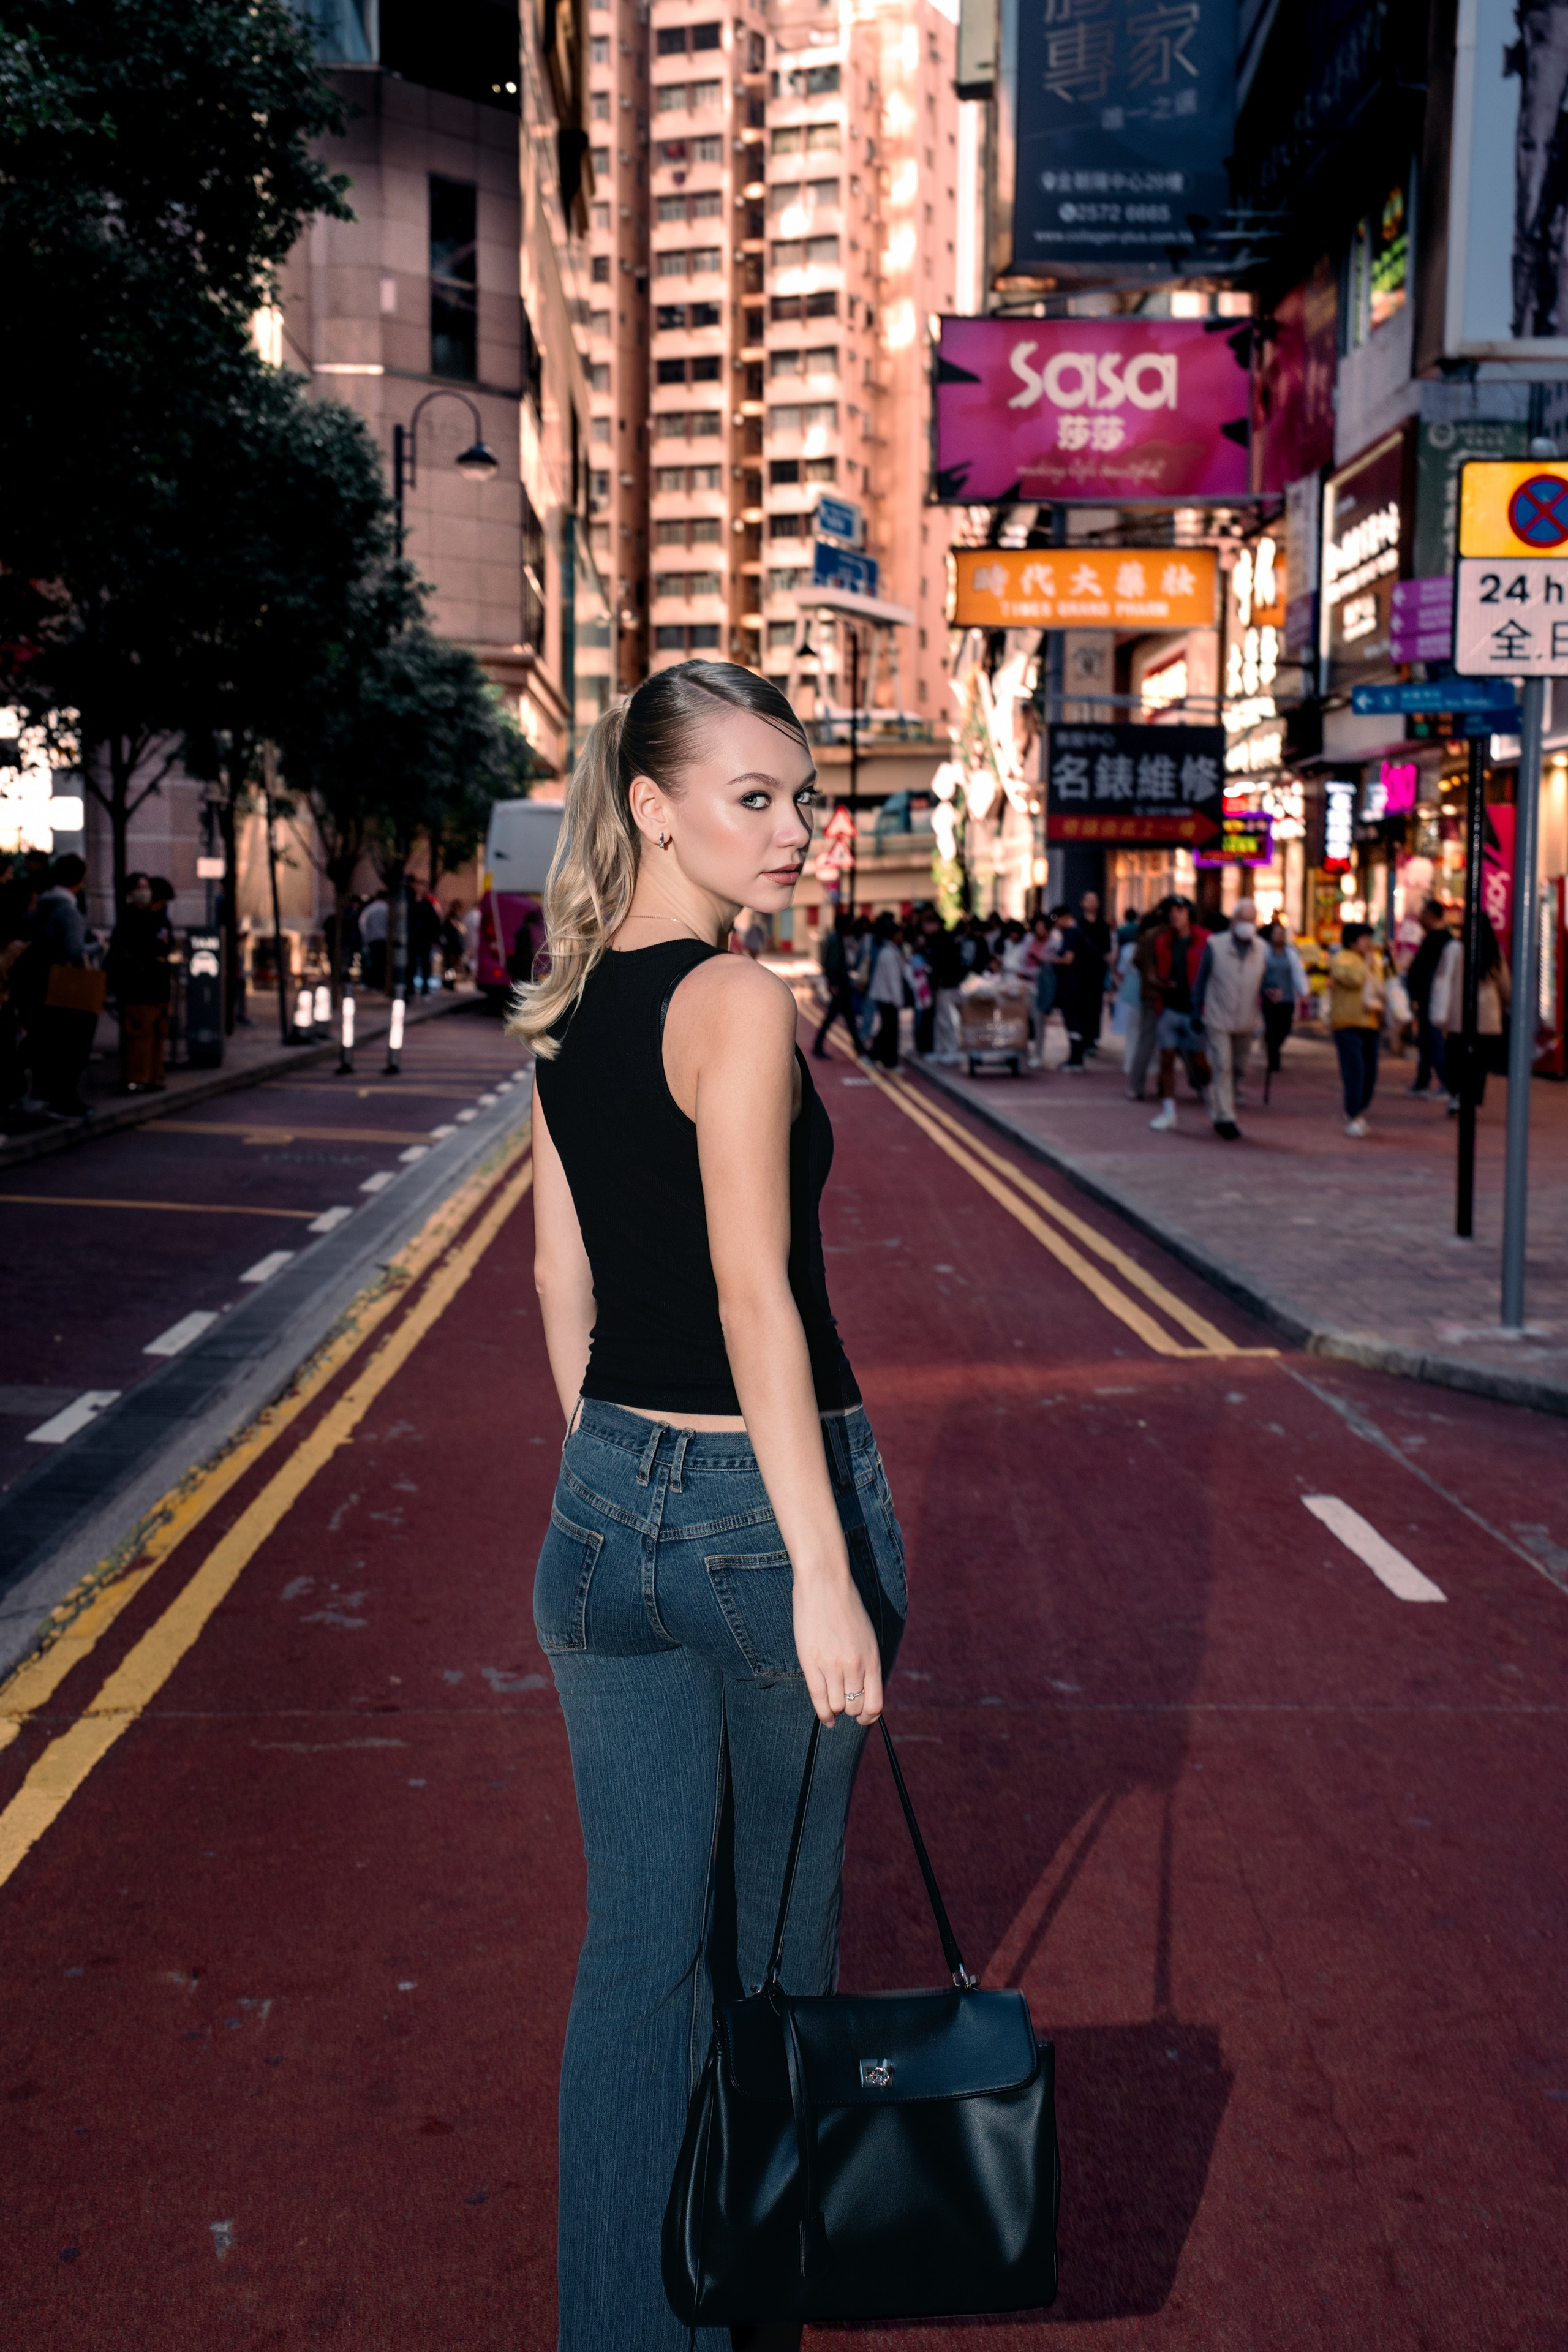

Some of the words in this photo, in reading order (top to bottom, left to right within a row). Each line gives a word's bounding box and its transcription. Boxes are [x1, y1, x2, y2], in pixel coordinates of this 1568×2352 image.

[1056, 414, 1126, 451] 莎莎
[1479, 574, 1529, 603] 24
[1052, 753, 1219, 803] 名錶維修
